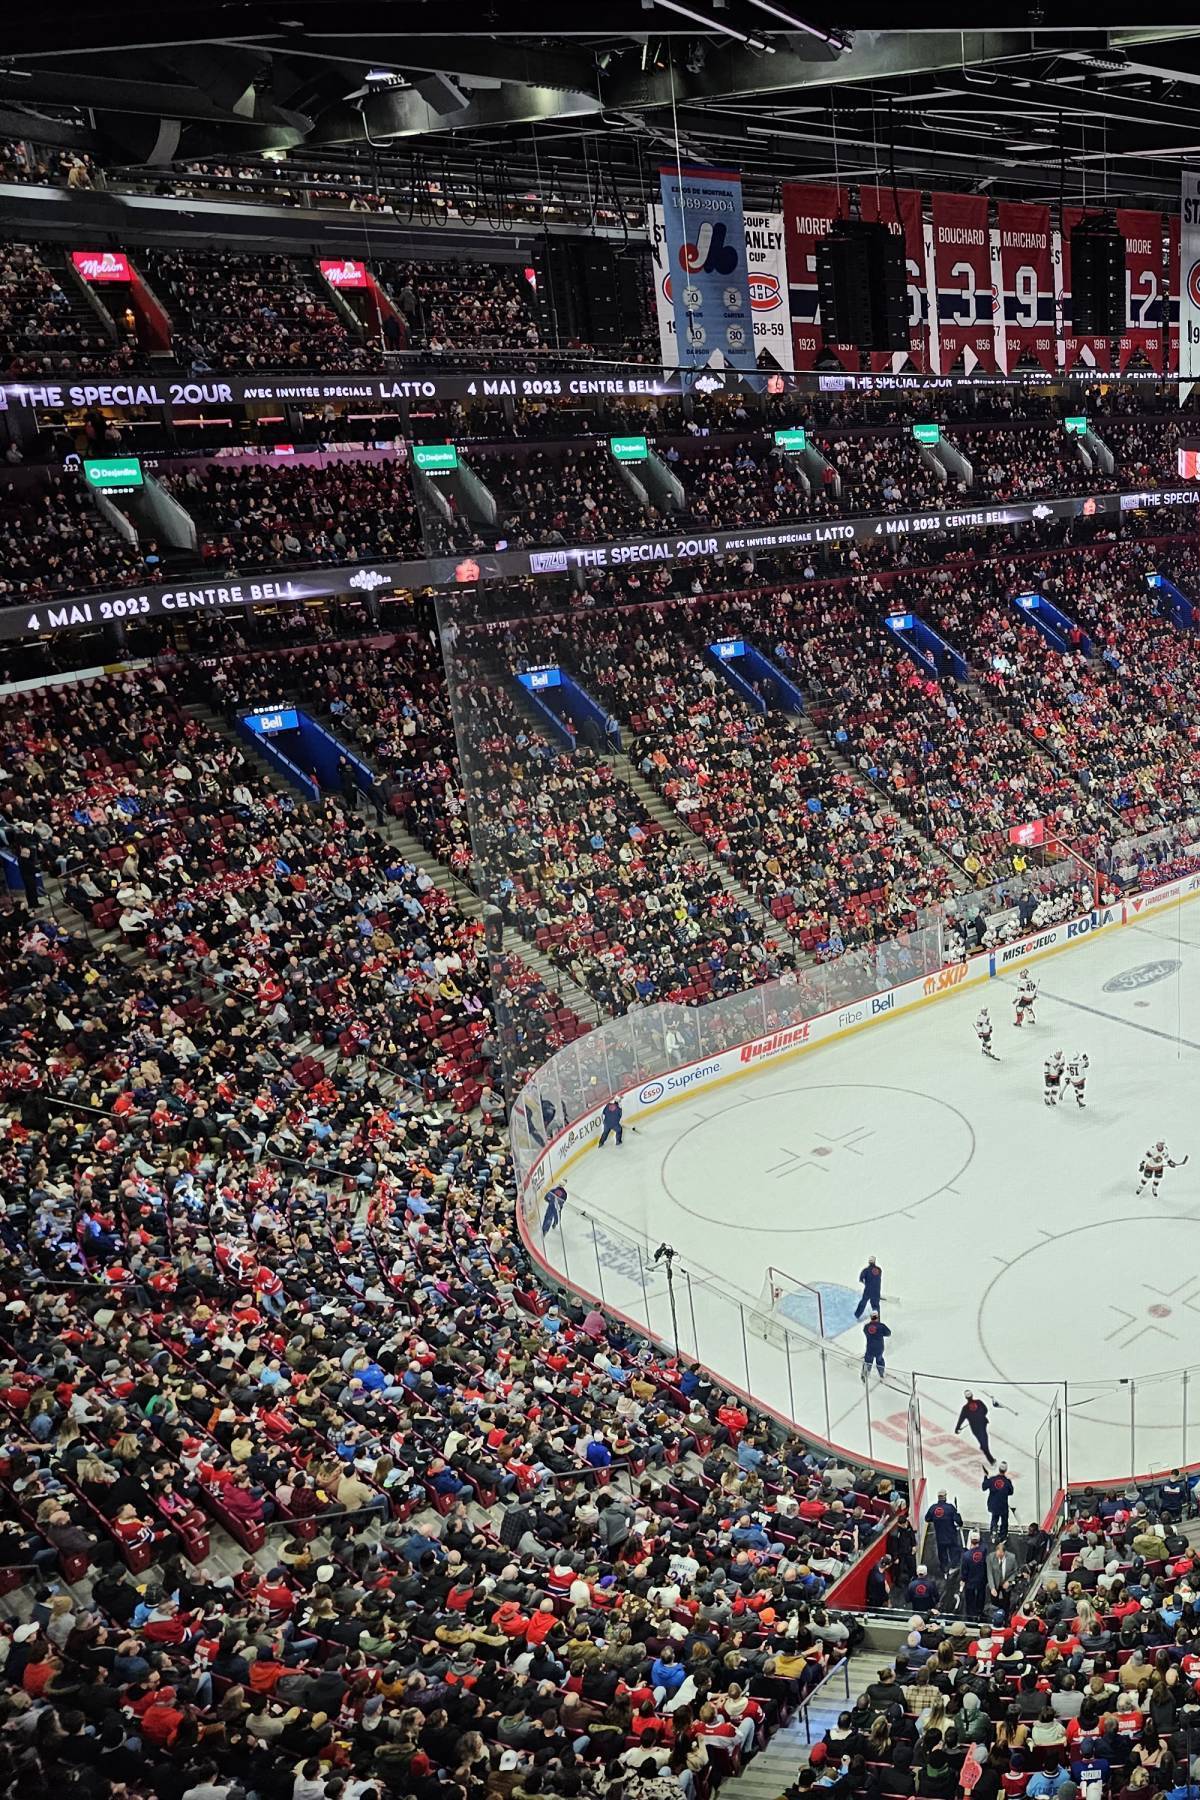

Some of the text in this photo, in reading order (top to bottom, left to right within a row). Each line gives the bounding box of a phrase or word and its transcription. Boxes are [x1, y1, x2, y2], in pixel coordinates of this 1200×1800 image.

[672, 197, 736, 212] 1969-2004
[796, 216, 833, 236] MOREN
[745, 231, 782, 250] ANLEY
[938, 227, 985, 246] BOUCHARD
[1126, 238, 1152, 255] MOORE
[749, 252, 767, 262] CUP
[79, 260, 124, 274] Molson
[325, 267, 362, 281] Molson
[729, 293, 736, 304] 8
[951, 262, 977, 328] 3
[1015, 265, 1039, 328] 9
[729, 329, 742, 340] 30
[753, 323, 784, 336] 58-59
[798, 338, 816, 351] 1923
[943, 338, 957, 350] 1941
[976, 338, 991, 350] 1956
[1006, 338, 1021, 350] 1942
[1035, 338, 1050, 350] 1960
[1065, 338, 1078, 350] 1947
[1093, 338, 1107, 350] 1961
[1120, 338, 1132, 350] 1951
[1145, 338, 1159, 350] 1963
[18, 386, 61, 408] THE
[69, 385, 165, 406] SPECIAL
[244, 388, 272, 399] AVEC
[276, 386, 321, 398] INVITÉE
[323, 385, 373, 397] SPÉCIALE
[379, 382, 436, 398] LATTO
[467, 380, 660, 396] 4 MAI 2023 CENTRE BELL
[63, 464, 79, 472] 222
[144, 460, 158, 468] 223
[101, 466, 137, 478] Desjardins
[1142, 493, 1161, 507] THE
[875, 511, 1008, 535] 4 MAI 2023 CENTRE BELL
[576, 550, 606, 567] THE
[611, 544, 673, 564] SPECIAL
[726, 540, 745, 549] AVEC
[747, 536, 776, 547] INVITÉE
[778, 532, 812, 544] SPÉCIALE
[816, 526, 855, 541] LATTO
[28, 582, 295, 631] 4 MAI 2023 CENTRE BELL
[720, 646, 735, 656] Bell
[532, 673, 548, 686] Bell
[261, 716, 282, 728] Bell
[937, 963, 969, 992] SKIP
[1119, 963, 1171, 988] Ford
[838, 993, 894, 1029] Fibe Bell
[740, 1023, 811, 1063] Qualinet
[667, 1062, 721, 1091] Suprême
[578, 1116, 602, 1142] EXPO
